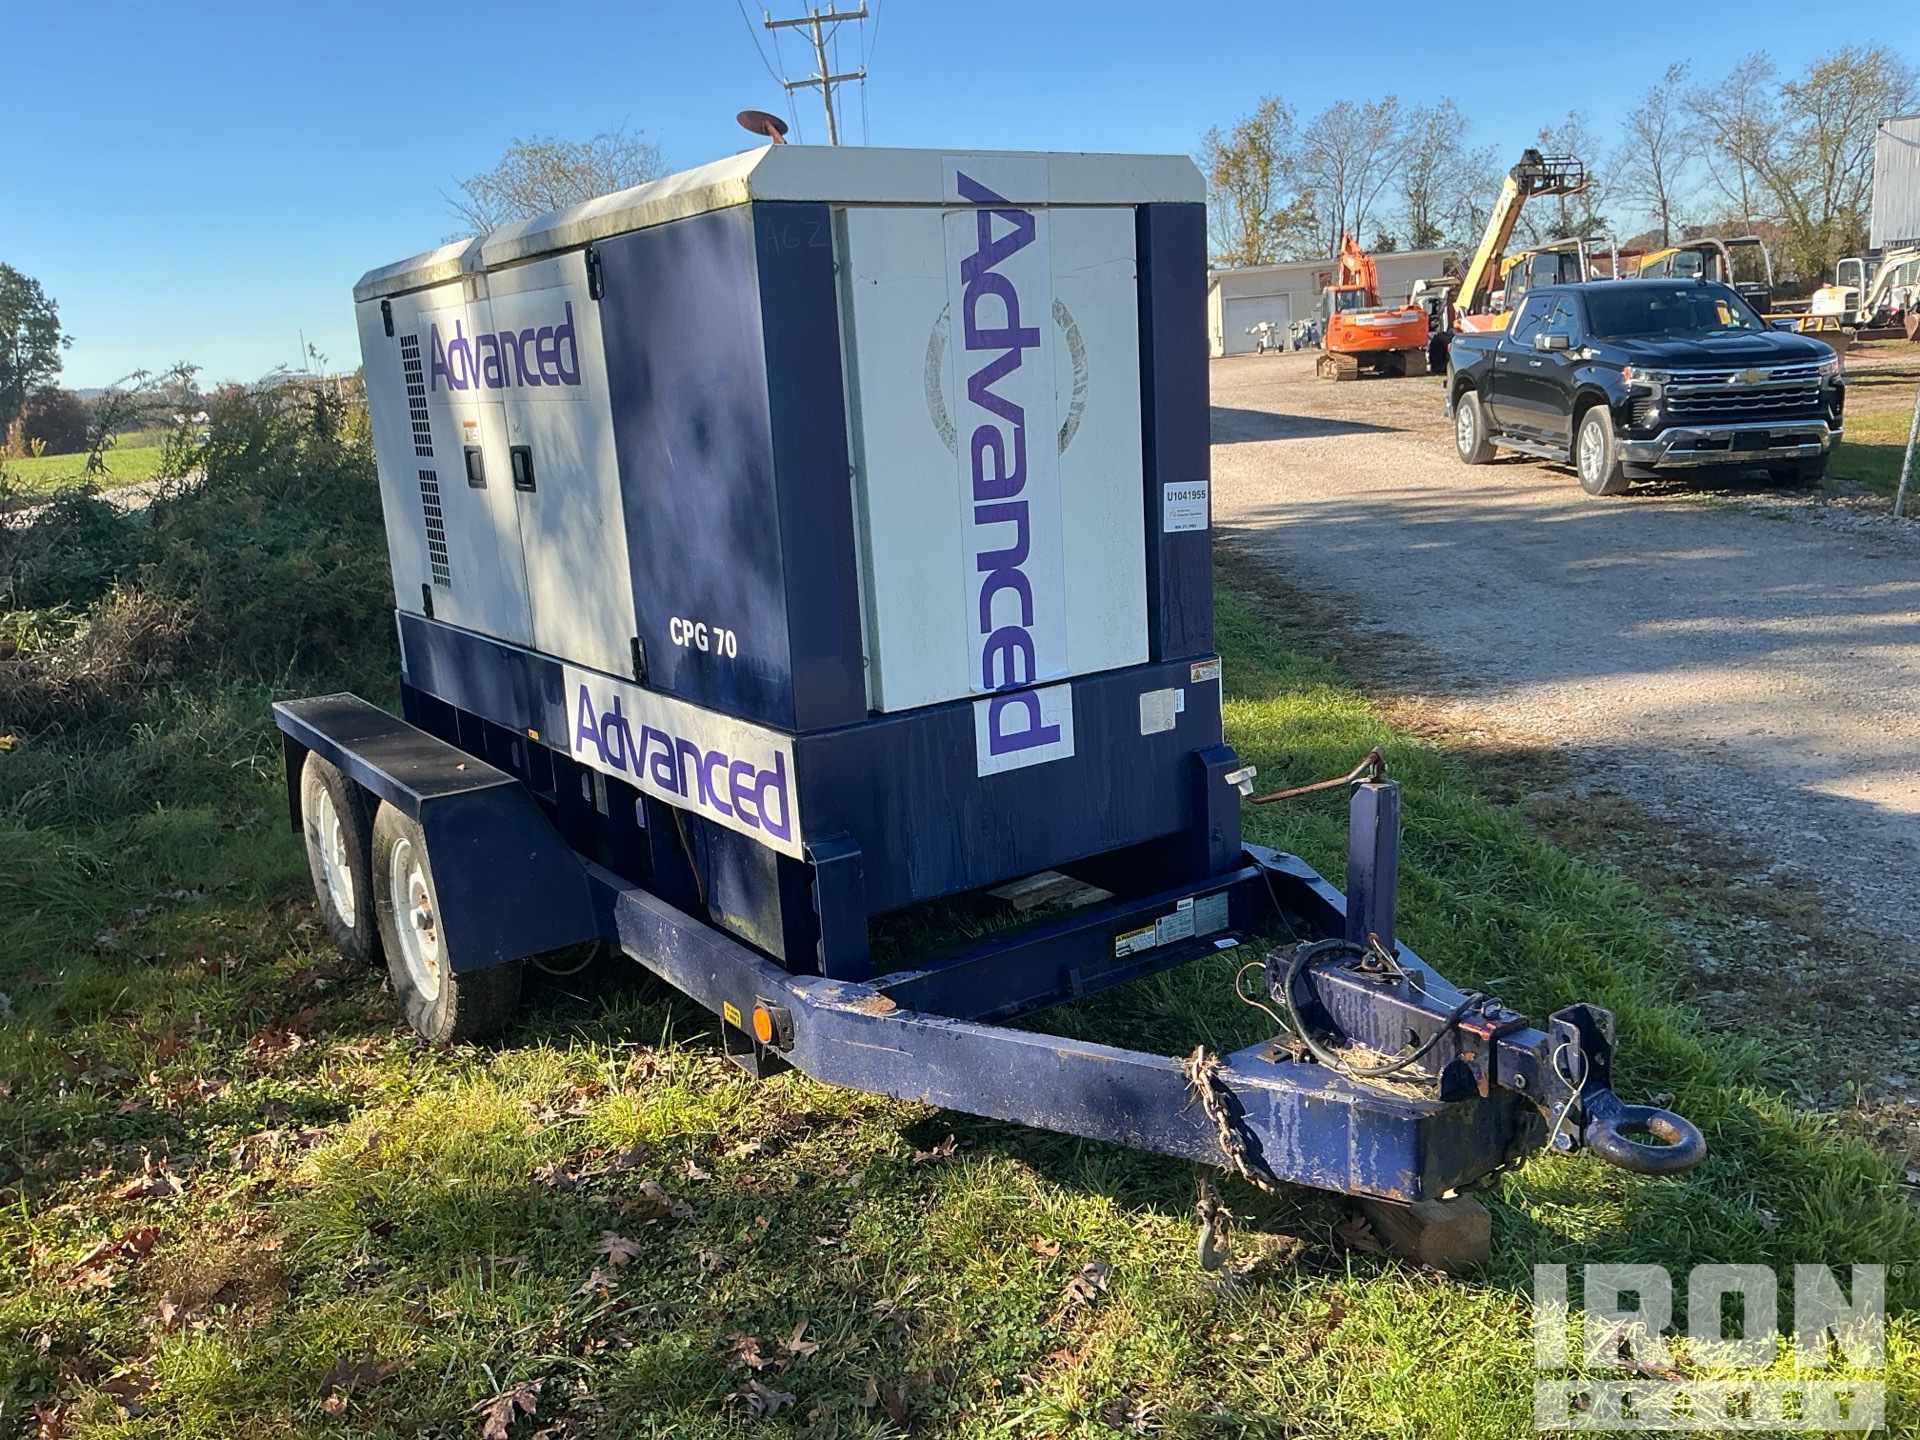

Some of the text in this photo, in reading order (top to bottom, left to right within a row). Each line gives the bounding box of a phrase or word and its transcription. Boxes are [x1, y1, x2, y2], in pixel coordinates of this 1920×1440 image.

[431, 301, 581, 392] Advanced
[957, 170, 1061, 757] Advanced
[1167, 490, 1206, 501] U1041955
[670, 616, 737, 659] CPG 70
[576, 684, 791, 842] Advanced
